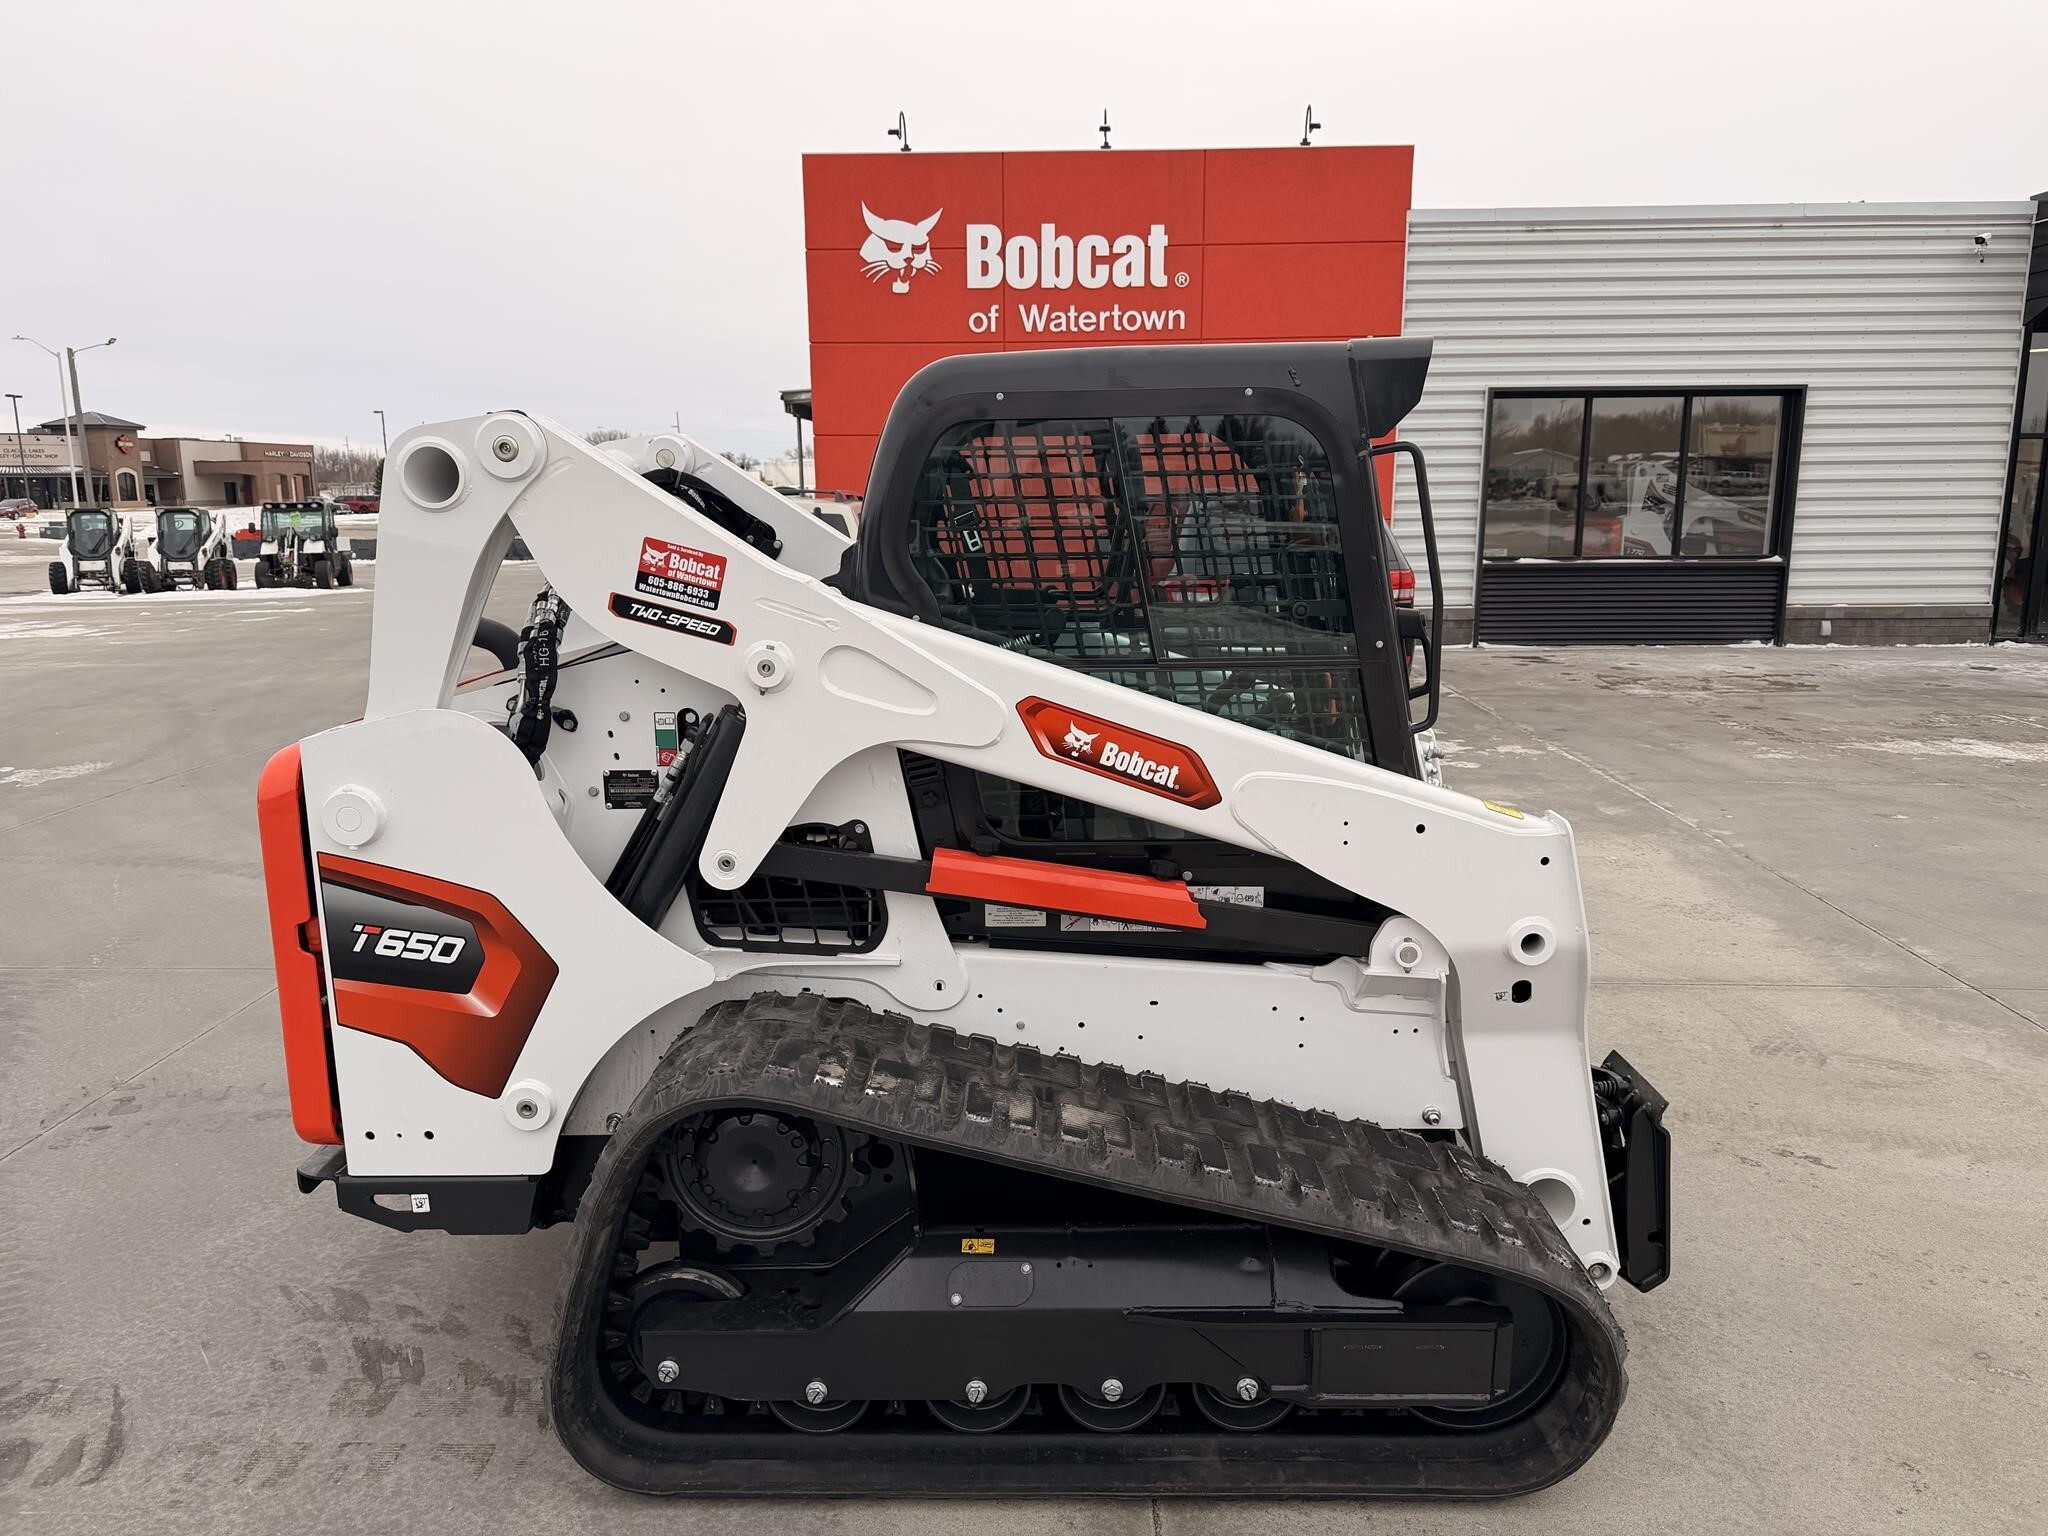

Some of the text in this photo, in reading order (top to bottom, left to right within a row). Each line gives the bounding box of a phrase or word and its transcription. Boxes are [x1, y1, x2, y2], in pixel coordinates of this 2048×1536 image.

[966, 223, 1169, 290] Bobcat
[968, 304, 1186, 333] of Watertown
[667, 569, 718, 588] of Watertown
[668, 552, 720, 580] Bobcat
[639, 582, 715, 609] WatertownBobcat.com
[648, 575, 709, 599] 605-886-6933
[630, 603, 722, 636] TWO-SPEED
[1099, 741, 1180, 789] Bobcat
[352, 924, 467, 965] T650
